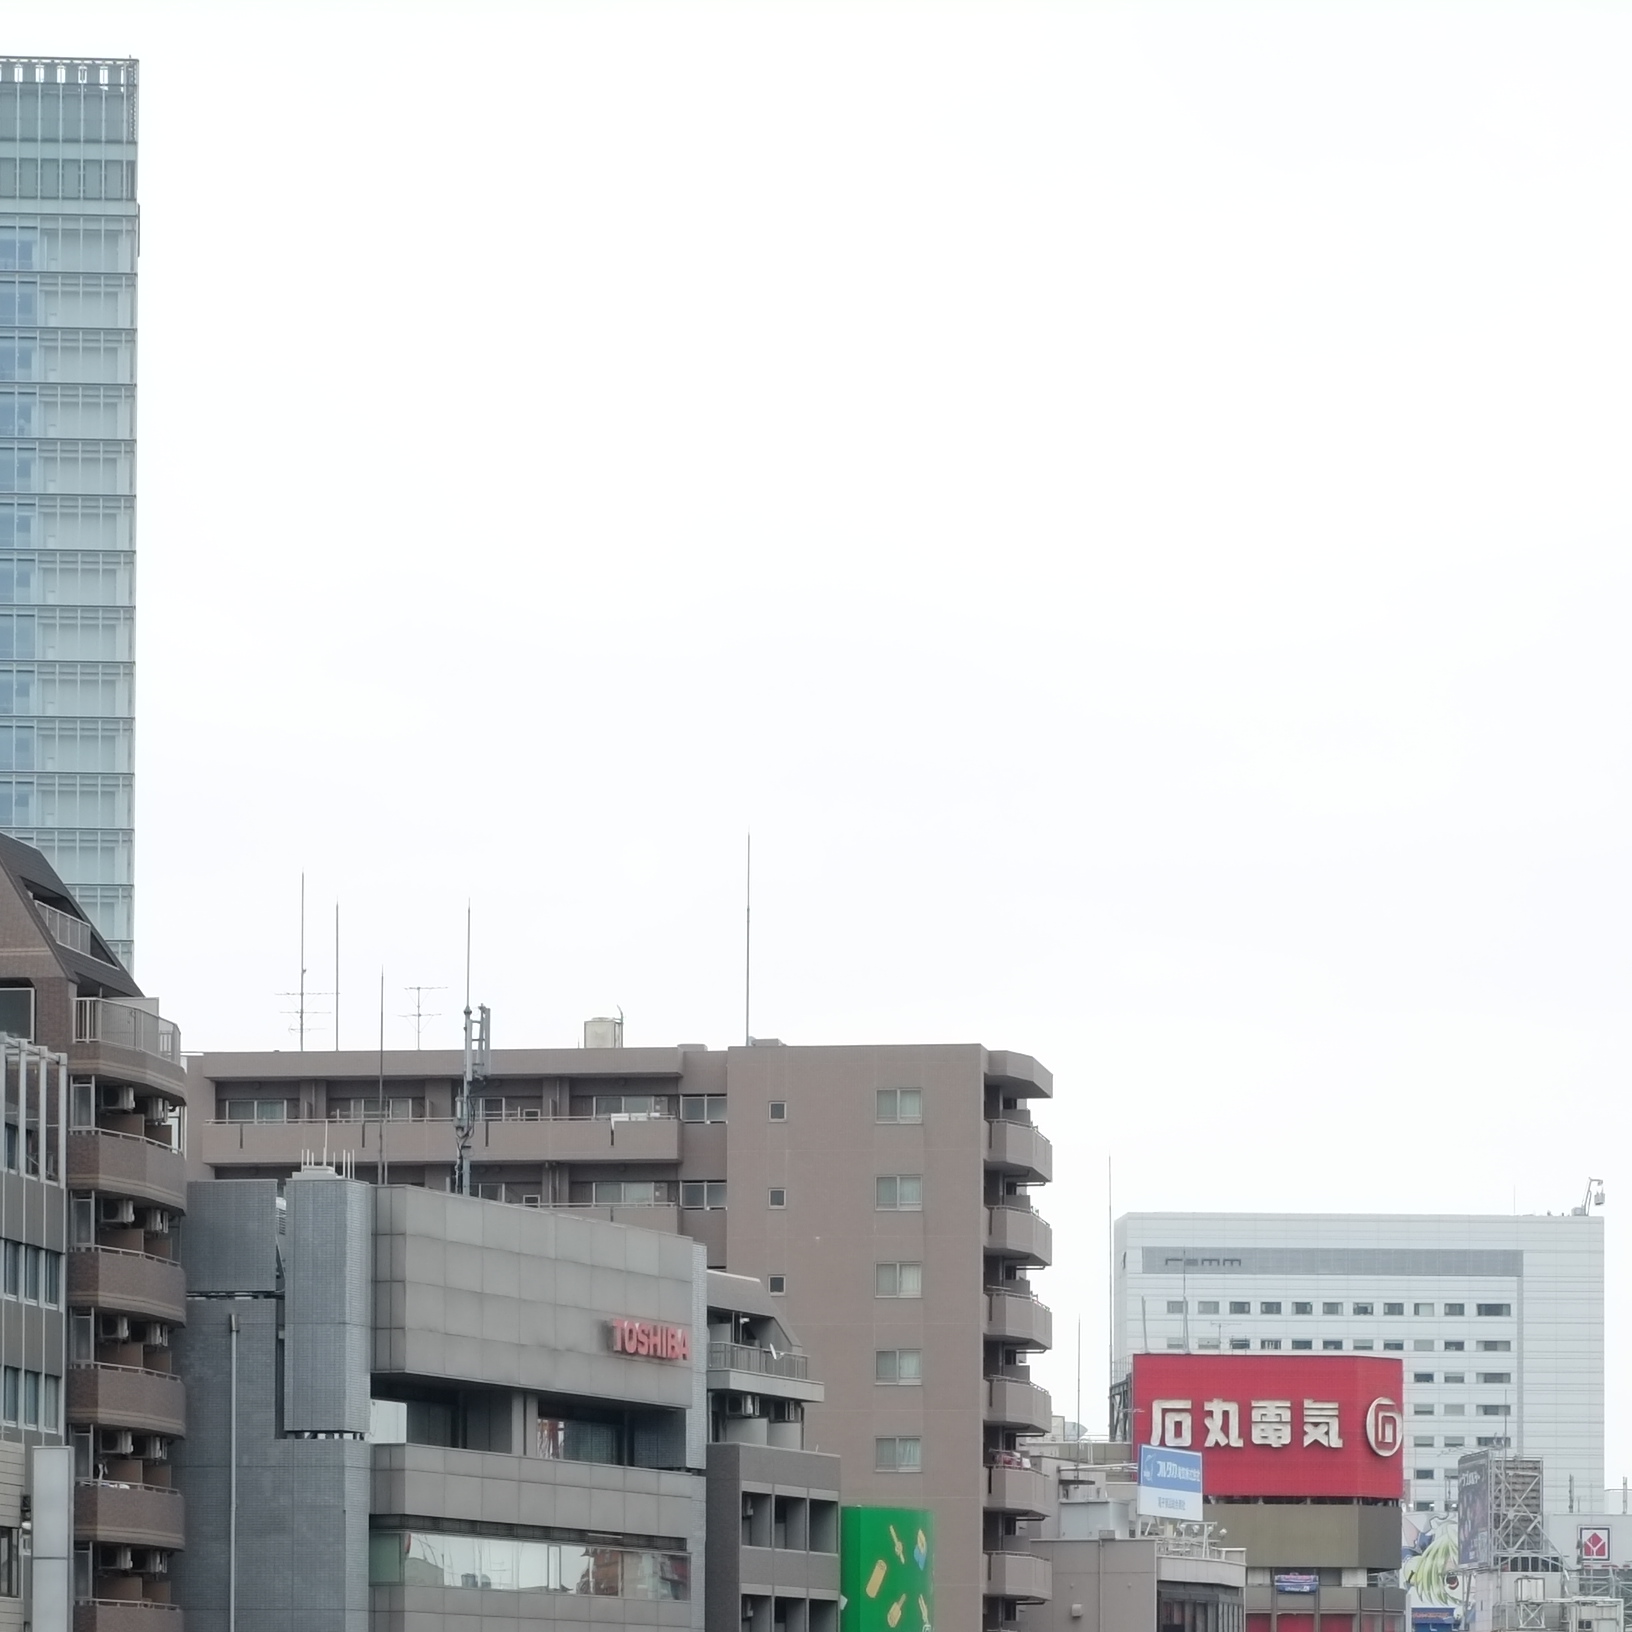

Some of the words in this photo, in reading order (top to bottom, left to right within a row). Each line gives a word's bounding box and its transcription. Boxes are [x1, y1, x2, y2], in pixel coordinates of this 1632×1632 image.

[612, 1318, 691, 1361] TOSHIBA
[1150, 1398, 1343, 1448] 石丸電気
